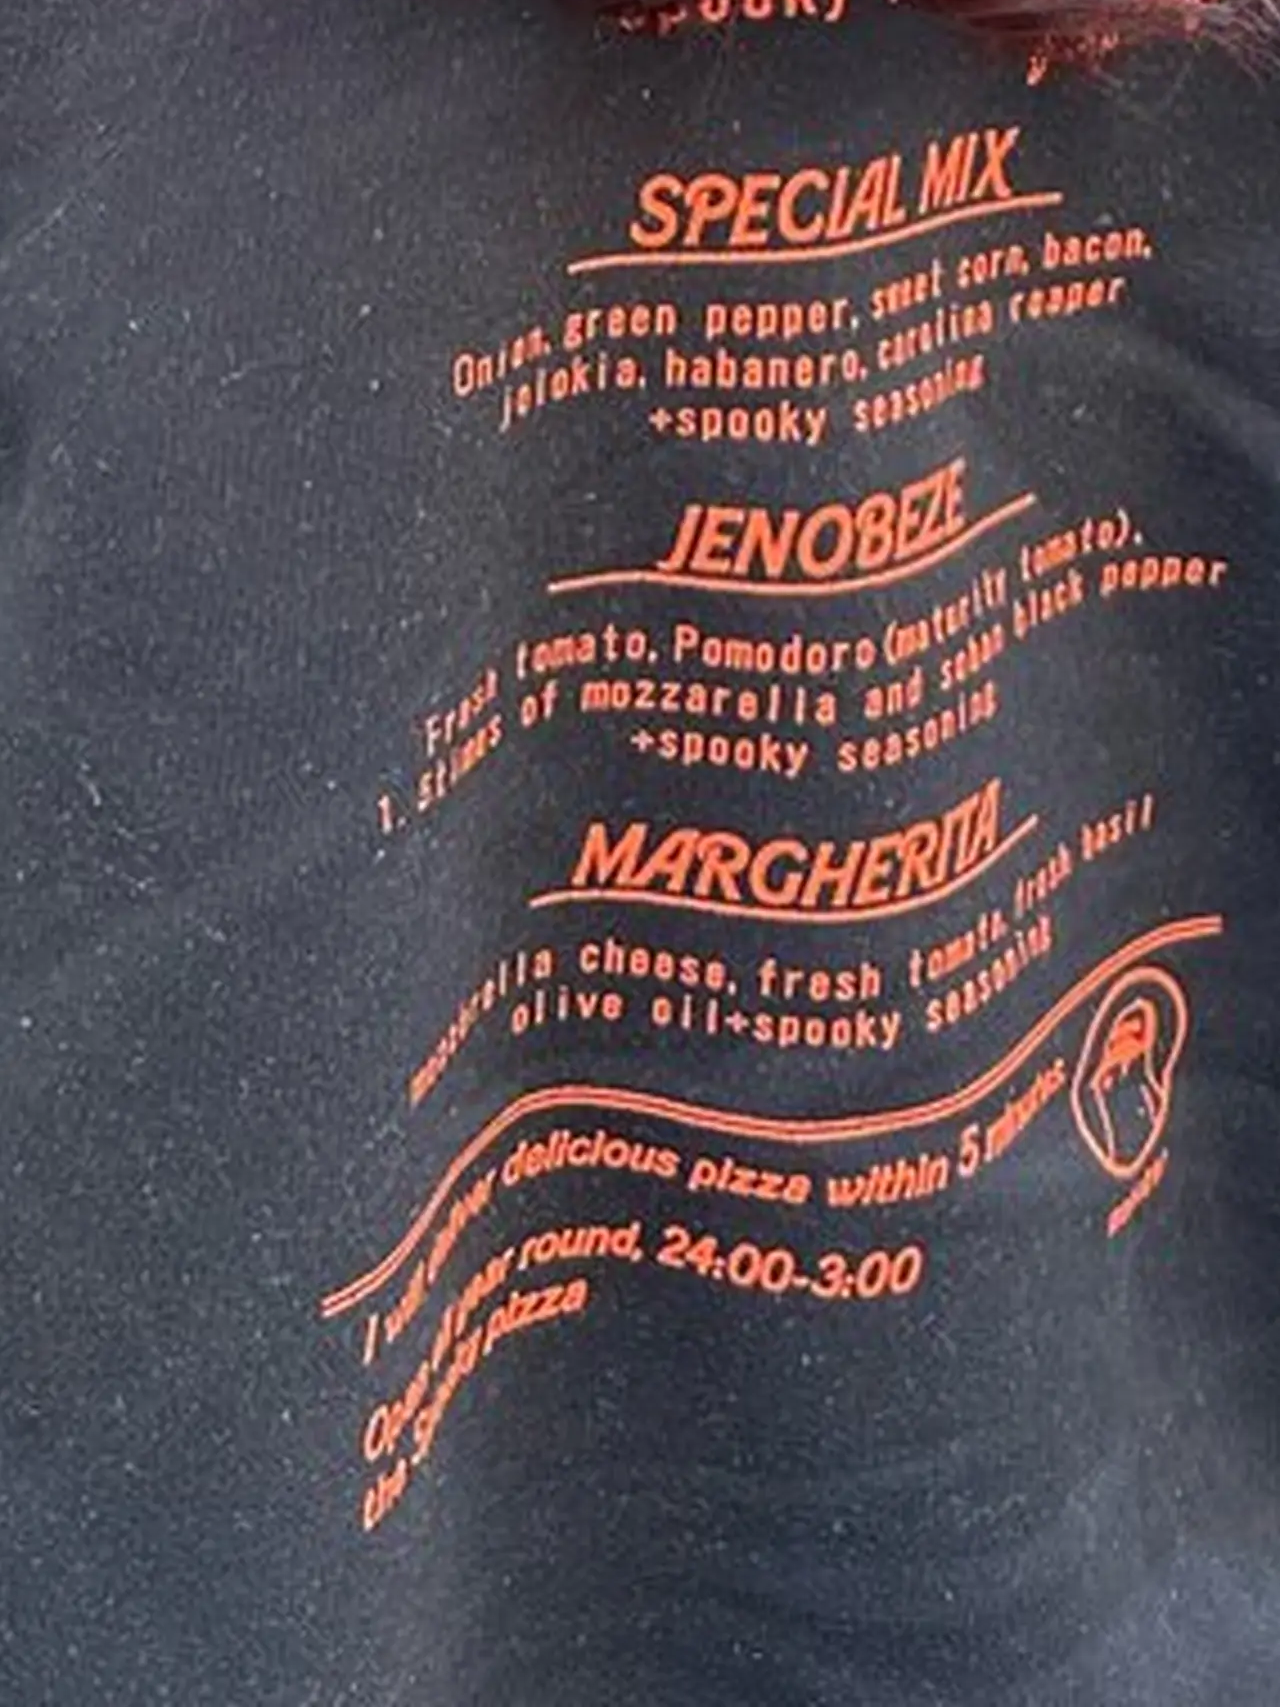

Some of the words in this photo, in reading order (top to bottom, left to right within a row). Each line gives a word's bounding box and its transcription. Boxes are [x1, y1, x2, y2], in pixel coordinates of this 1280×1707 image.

[630, 154, 907, 248] SPECIAL
[919, 126, 1020, 211] MIX
[563, 301, 677, 350] green
[705, 296, 859, 339] pepper,
[1042, 227, 1153, 269] bacon,
[665, 348, 868, 388] habanero,
[877, 299, 992, 371] carolina
[649, 399, 826, 446] +spooky
[658, 457, 967, 577] JENOBEZE
[521, 680, 558, 727] of
[580, 680, 837, 725] mozzarella
[865, 666, 924, 719] and
[1100, 555, 1227, 598] pepper
[675, 622, 876, 674] Pomodoro
[631, 729, 808, 778] +spooky
[572, 777, 1001, 907] MARGHERITA
[511, 985, 623, 1035] olive
[580, 938, 738, 997] cheese,
[758, 956, 882, 1002] fresh
[501, 1129, 680, 1186] delicious
[688, 1155, 812, 1206] pizza
[827, 1151, 951, 1208] within
[956, 1121, 981, 1179] 5
[656, 1224, 924, 1299] 24:00-3:00
[482, 1278, 590, 1357] pizza
